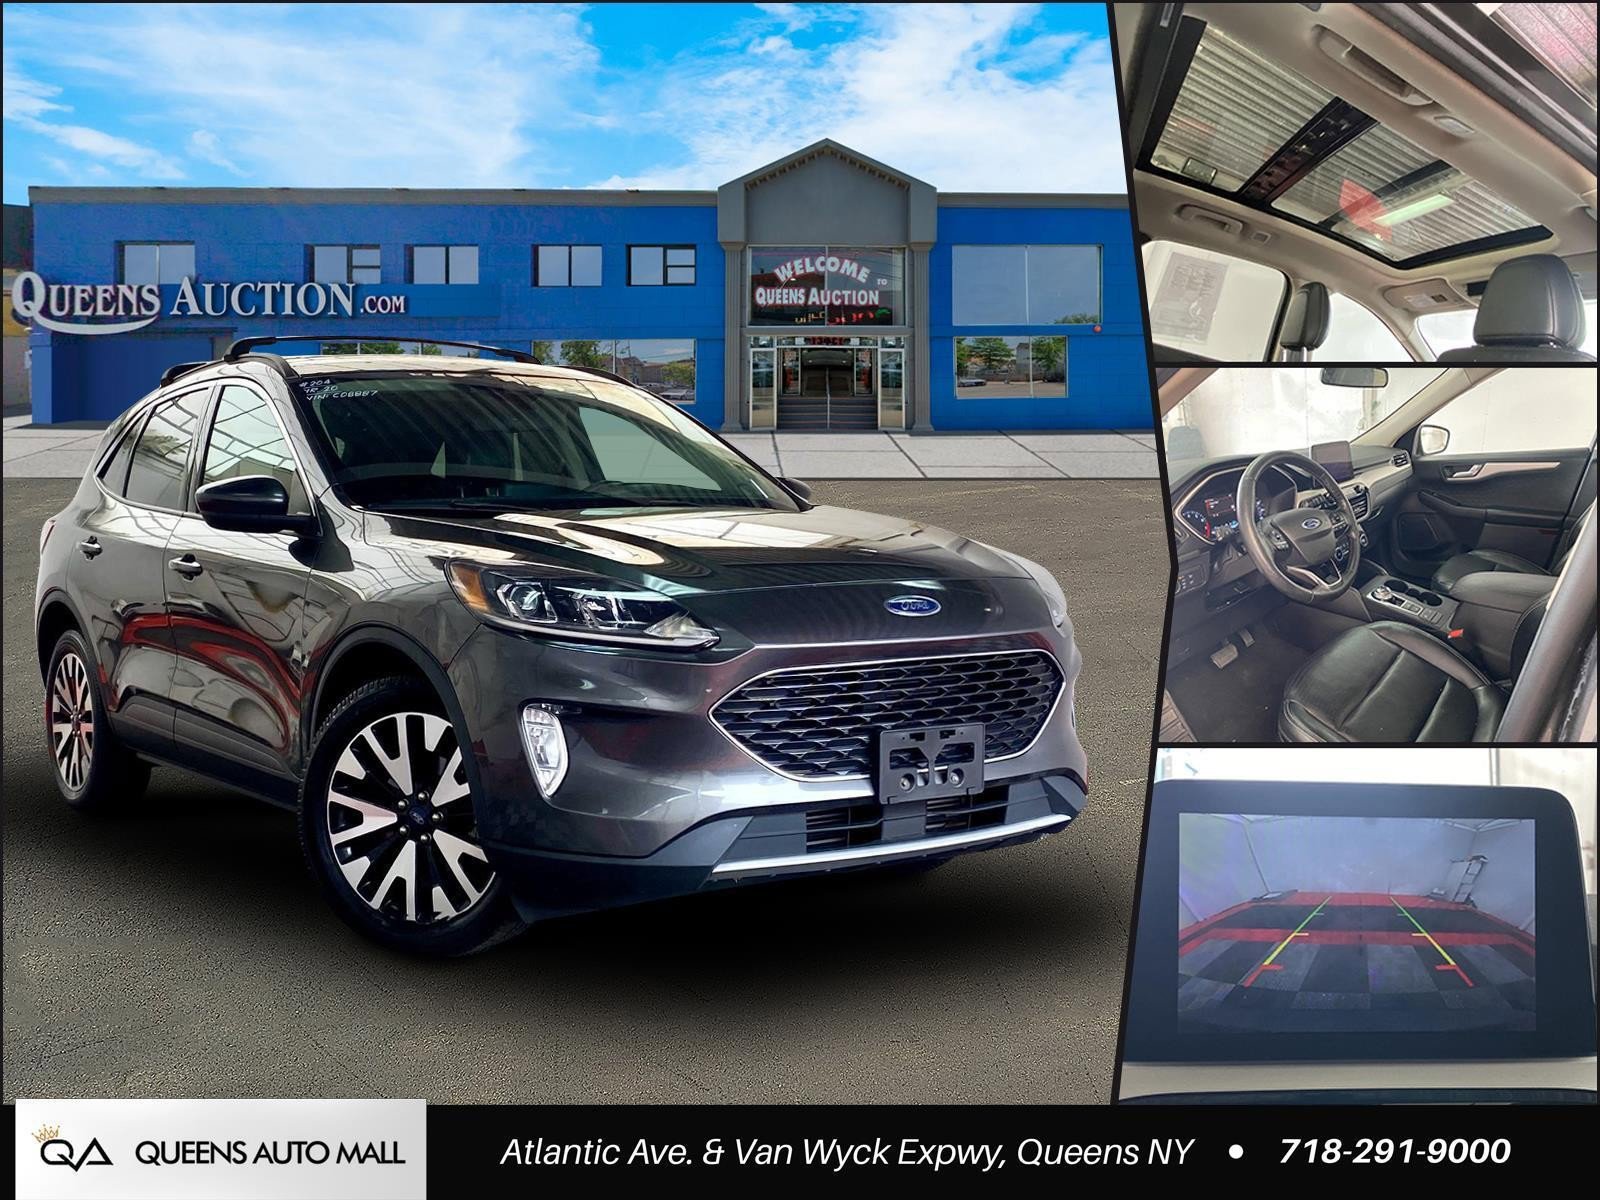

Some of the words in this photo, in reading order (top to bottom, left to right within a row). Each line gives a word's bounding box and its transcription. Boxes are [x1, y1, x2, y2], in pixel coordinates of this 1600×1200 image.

[773, 255, 872, 284] WELCOME
[12, 271, 160, 335] QUEENS
[755, 286, 806, 307] QUEENS
[807, 286, 879, 306] AUCTION
